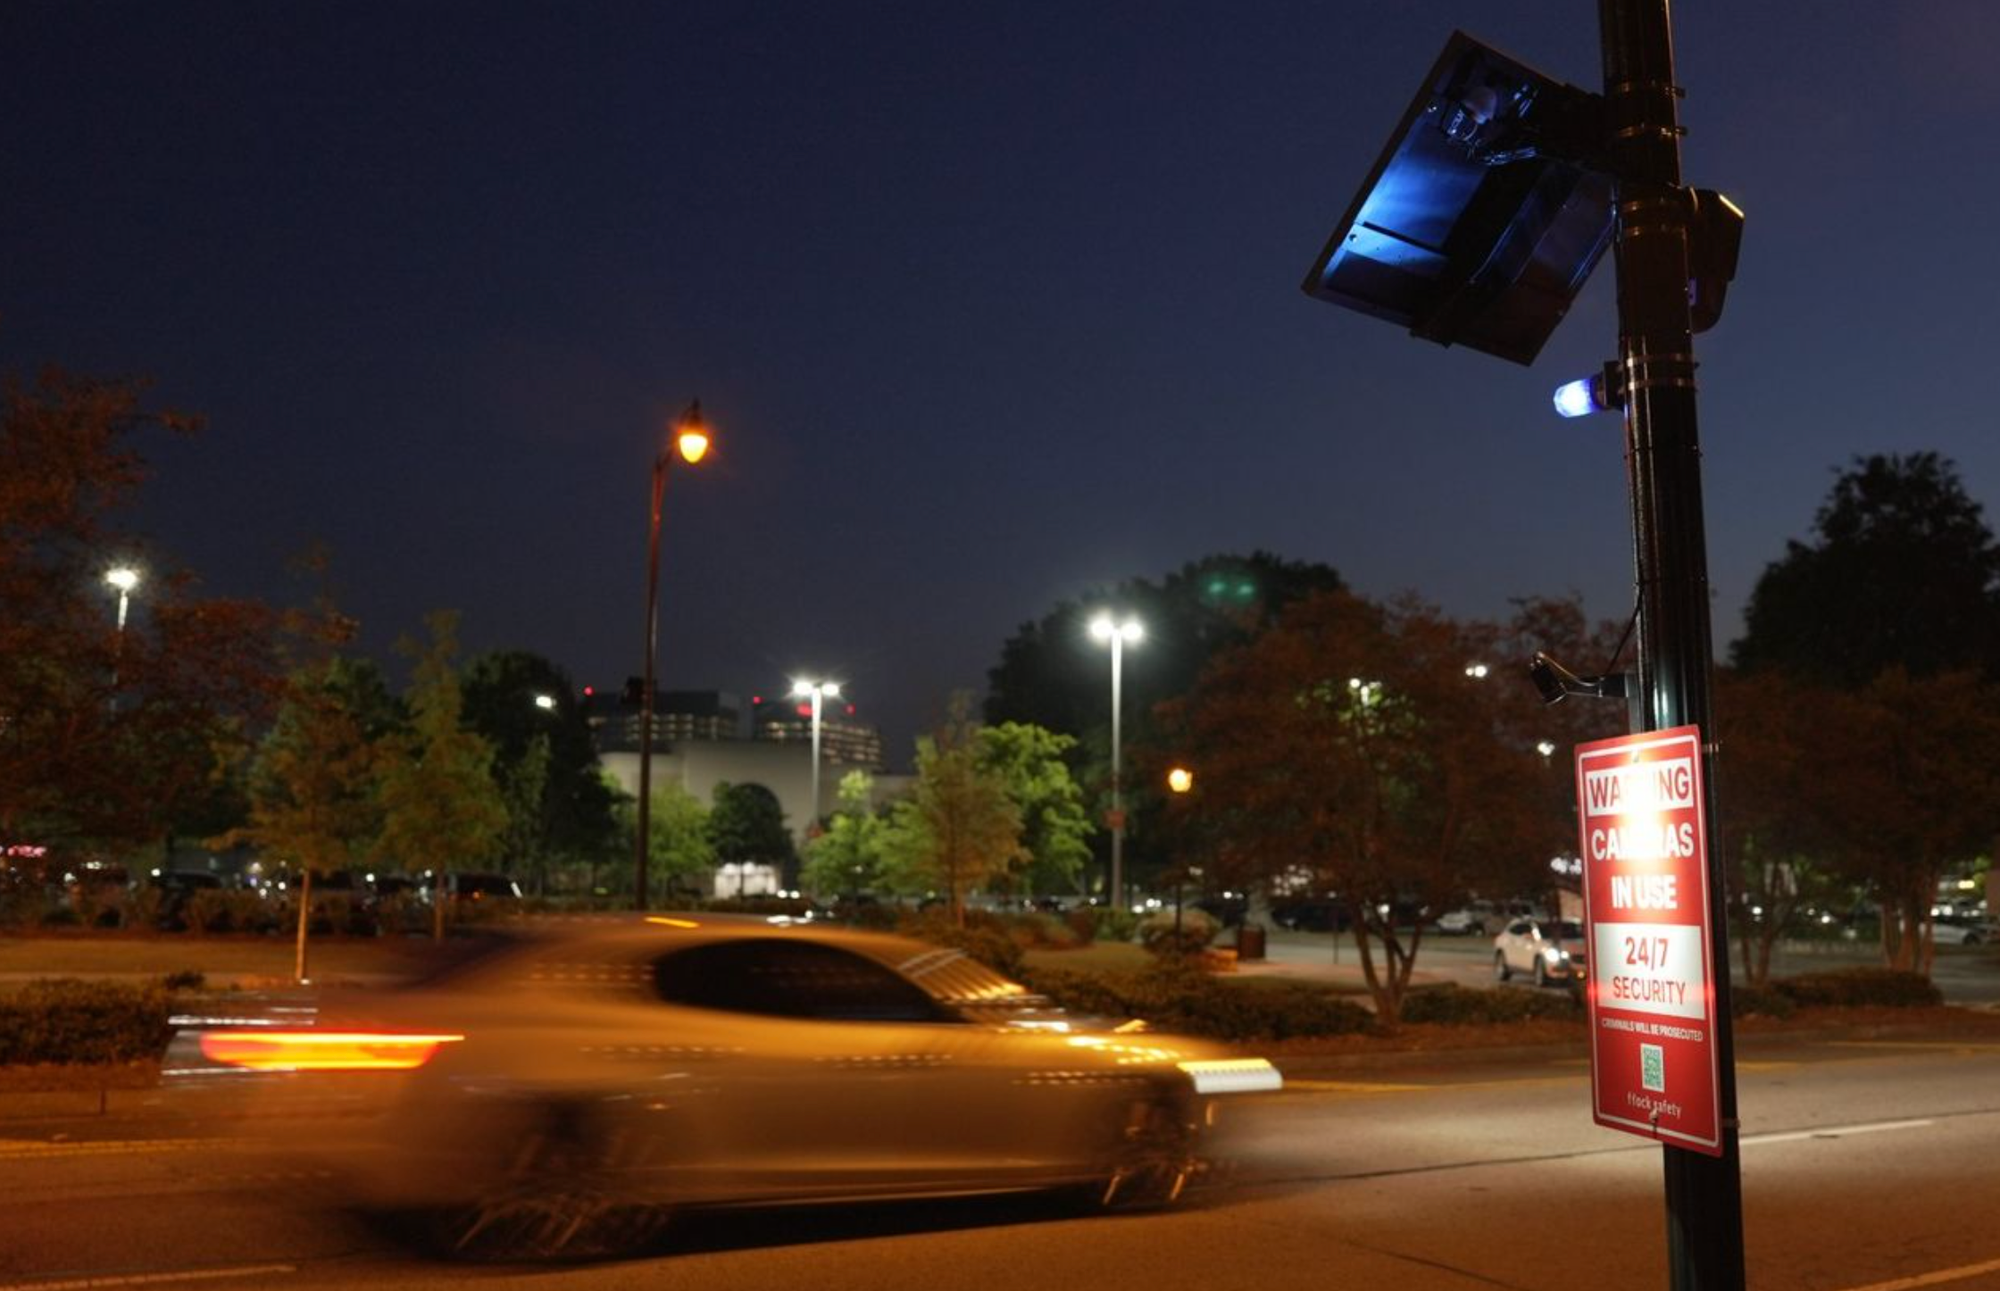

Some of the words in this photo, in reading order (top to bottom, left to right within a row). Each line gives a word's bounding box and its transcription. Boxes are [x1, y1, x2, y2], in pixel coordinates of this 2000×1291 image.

[1589, 766, 1689, 809] WANG
[1592, 822, 1694, 861] CAAS
[1611, 876, 1632, 909] IN
[1625, 936, 1669, 970] 24/7
[1613, 976, 1686, 1005] SECURITY
[1660, 1025, 1704, 1042] PROSECUTED
